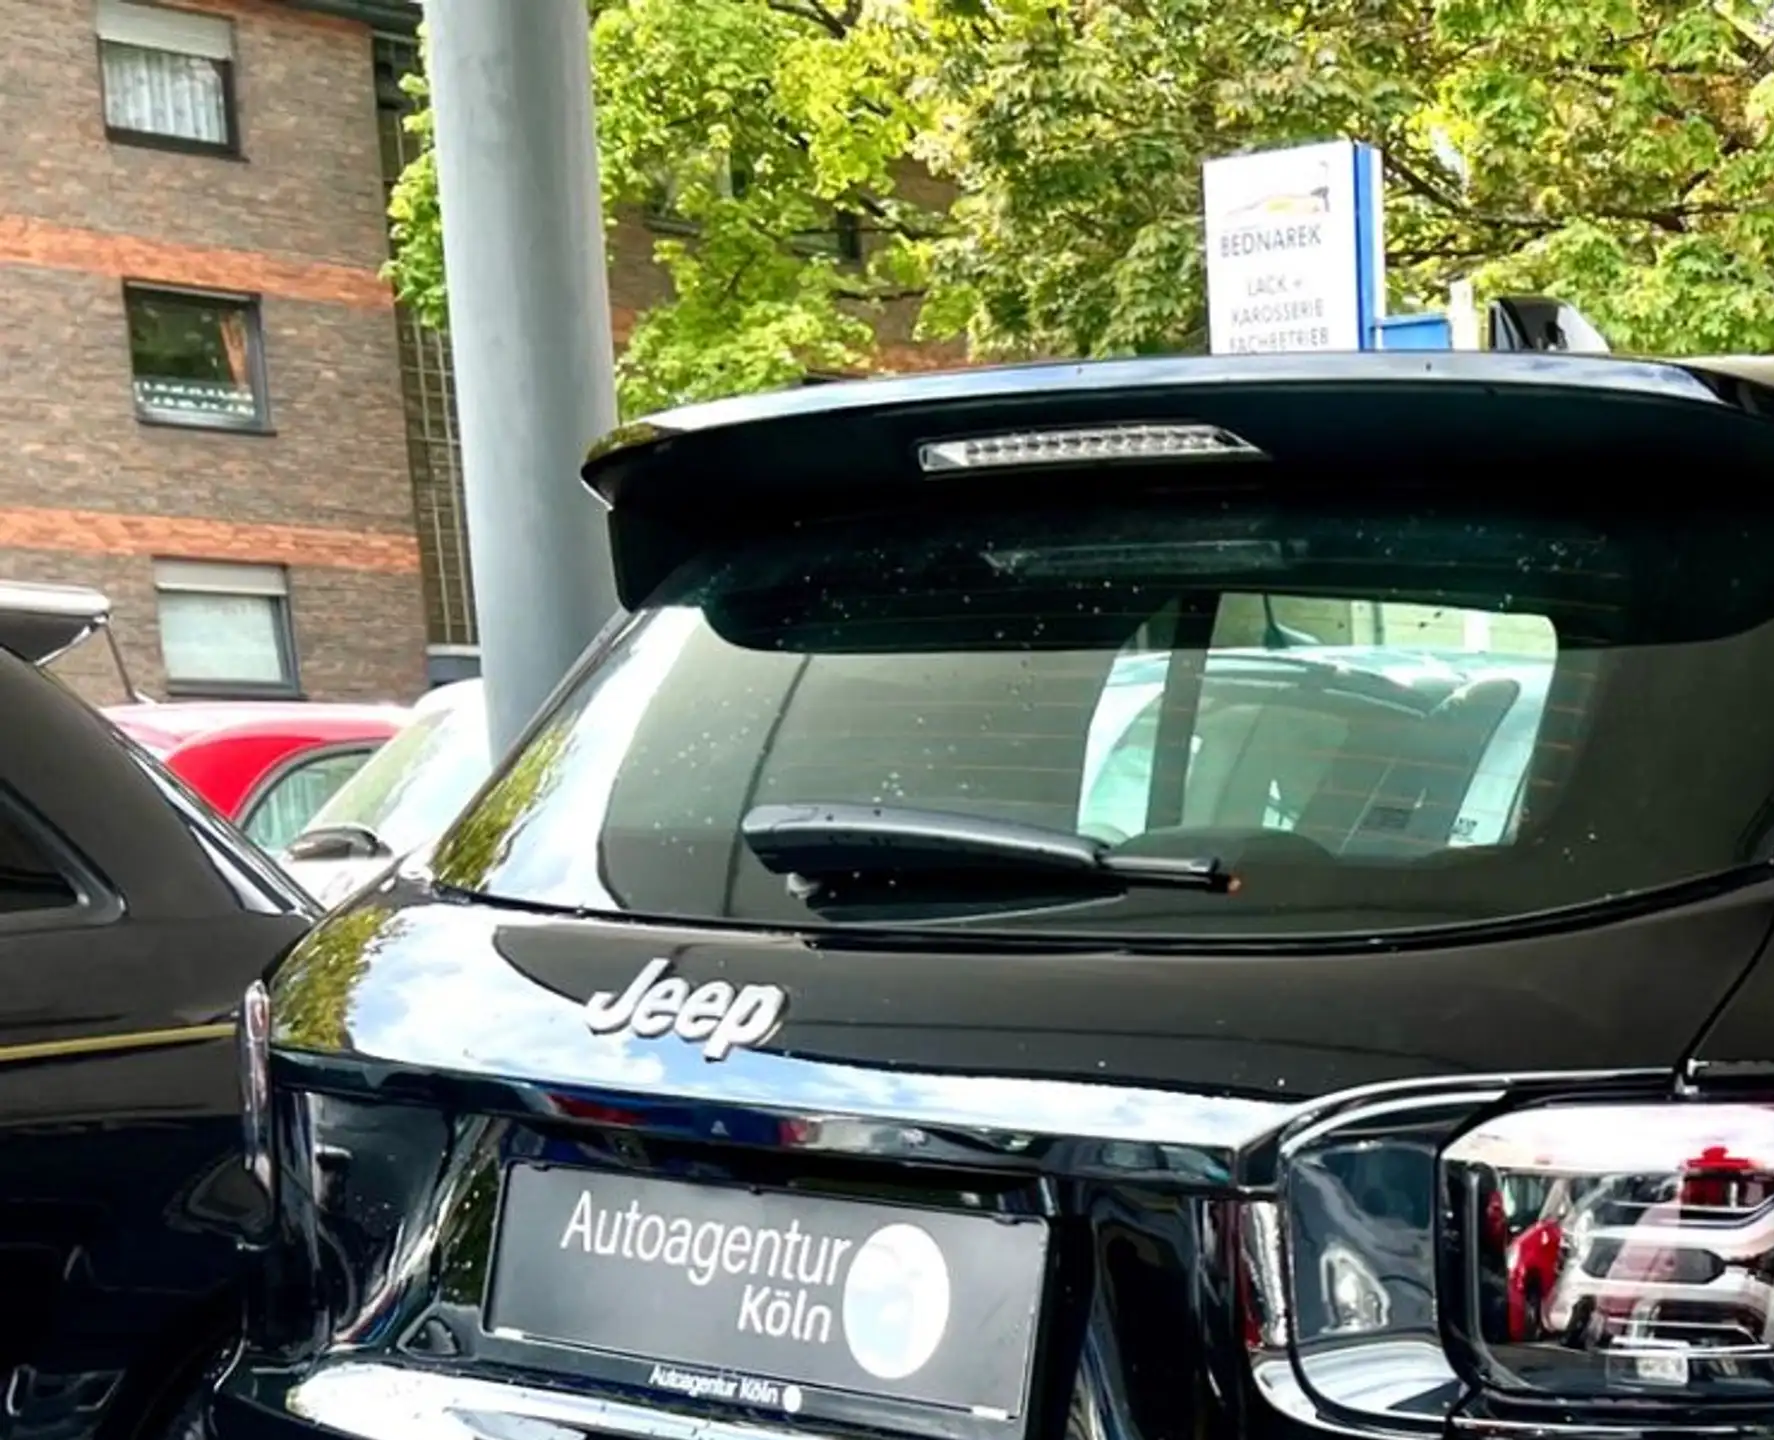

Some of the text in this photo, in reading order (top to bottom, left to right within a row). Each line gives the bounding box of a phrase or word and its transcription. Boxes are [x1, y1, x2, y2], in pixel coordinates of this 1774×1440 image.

[1219, 223, 1322, 259] BEDNAREK
[1246, 273, 1288, 296] LACK
[1230, 298, 1325, 328] KAROSSERIE
[584, 957, 788, 1062] Jeep
[560, 1191, 853, 1286] Autoagentur
[736, 1284, 831, 1344] Köln
[648, 1363, 779, 1405] Autoagentur Köln
